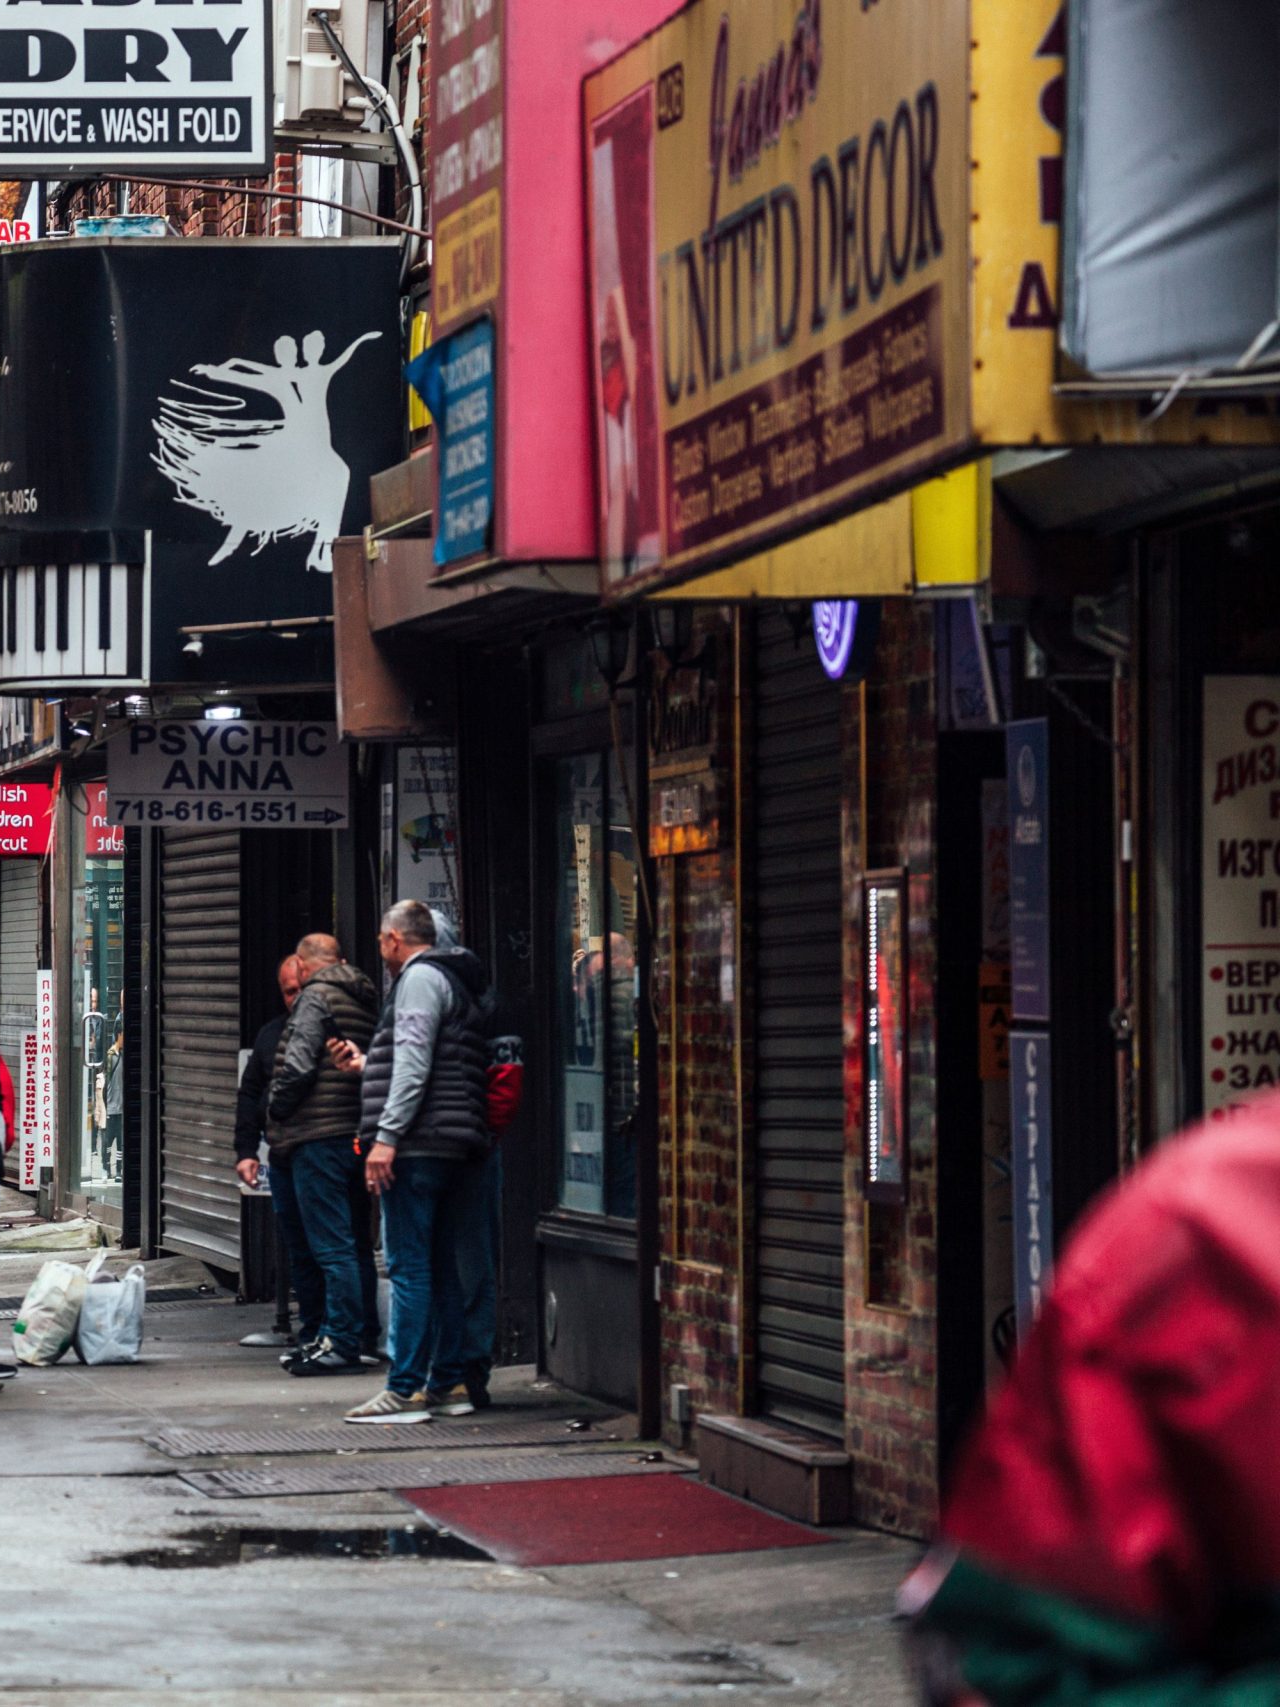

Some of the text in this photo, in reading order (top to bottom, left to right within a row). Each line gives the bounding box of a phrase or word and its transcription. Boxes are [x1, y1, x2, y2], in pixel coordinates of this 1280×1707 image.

[87, 124, 96, 142] &
[101, 107, 169, 143] WASH
[178, 107, 241, 143] FOLD
[658, 183, 802, 407] UNITED
[810, 80, 944, 336] DECOR
[129, 724, 328, 757] PSYCHIC
[162, 759, 294, 791] ANNA
[1213, 745, 1280, 805] ДИЗ
[115, 800, 297, 822] 718-616-1551
[23, 1034, 38, 1135] ИММИГРАЦИОННЫЕ
[41, 980, 52, 1156] ПАРИКМАХЕРСКАЯ
[24, 1143, 35, 1185] УСЛУГИ
